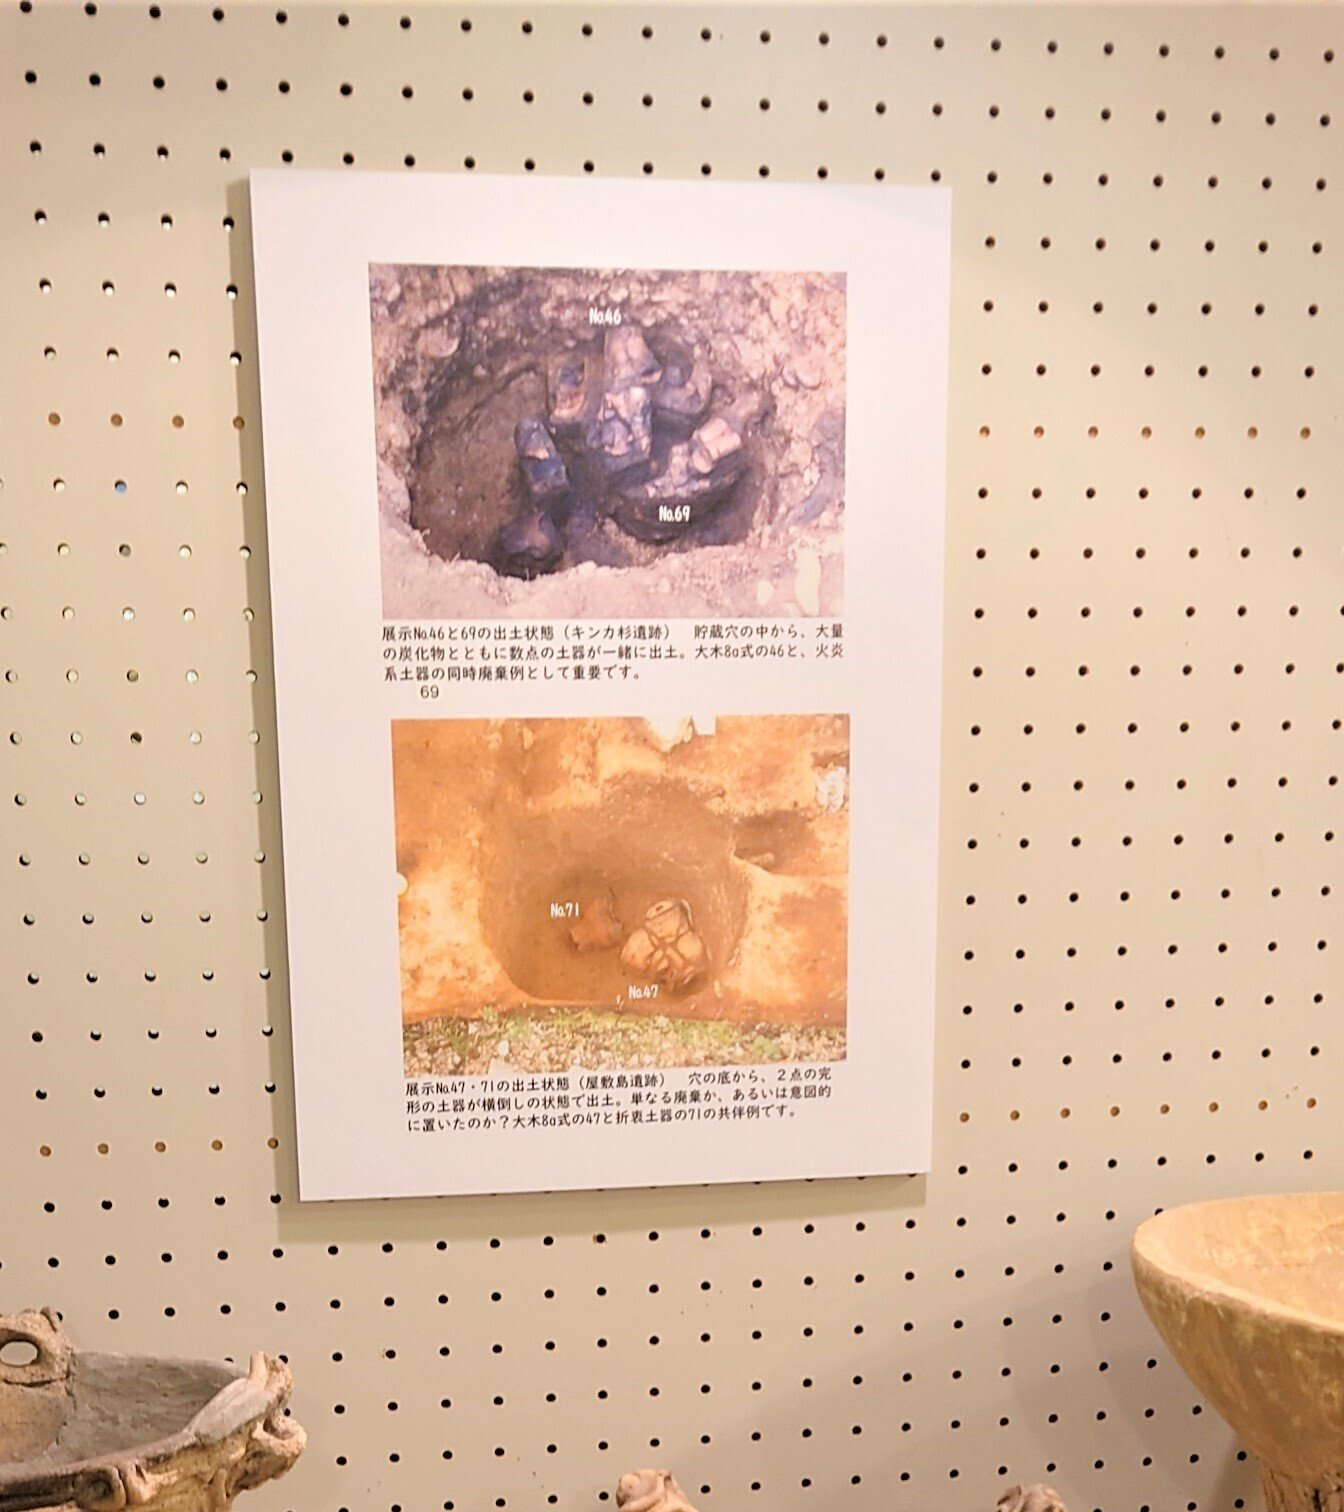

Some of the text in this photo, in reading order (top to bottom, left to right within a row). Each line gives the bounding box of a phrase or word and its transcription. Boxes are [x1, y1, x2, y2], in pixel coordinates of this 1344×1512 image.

[384, 664, 640, 682] 系土器の同時廃棄例として重要です。
[419, 684, 440, 699] 69
